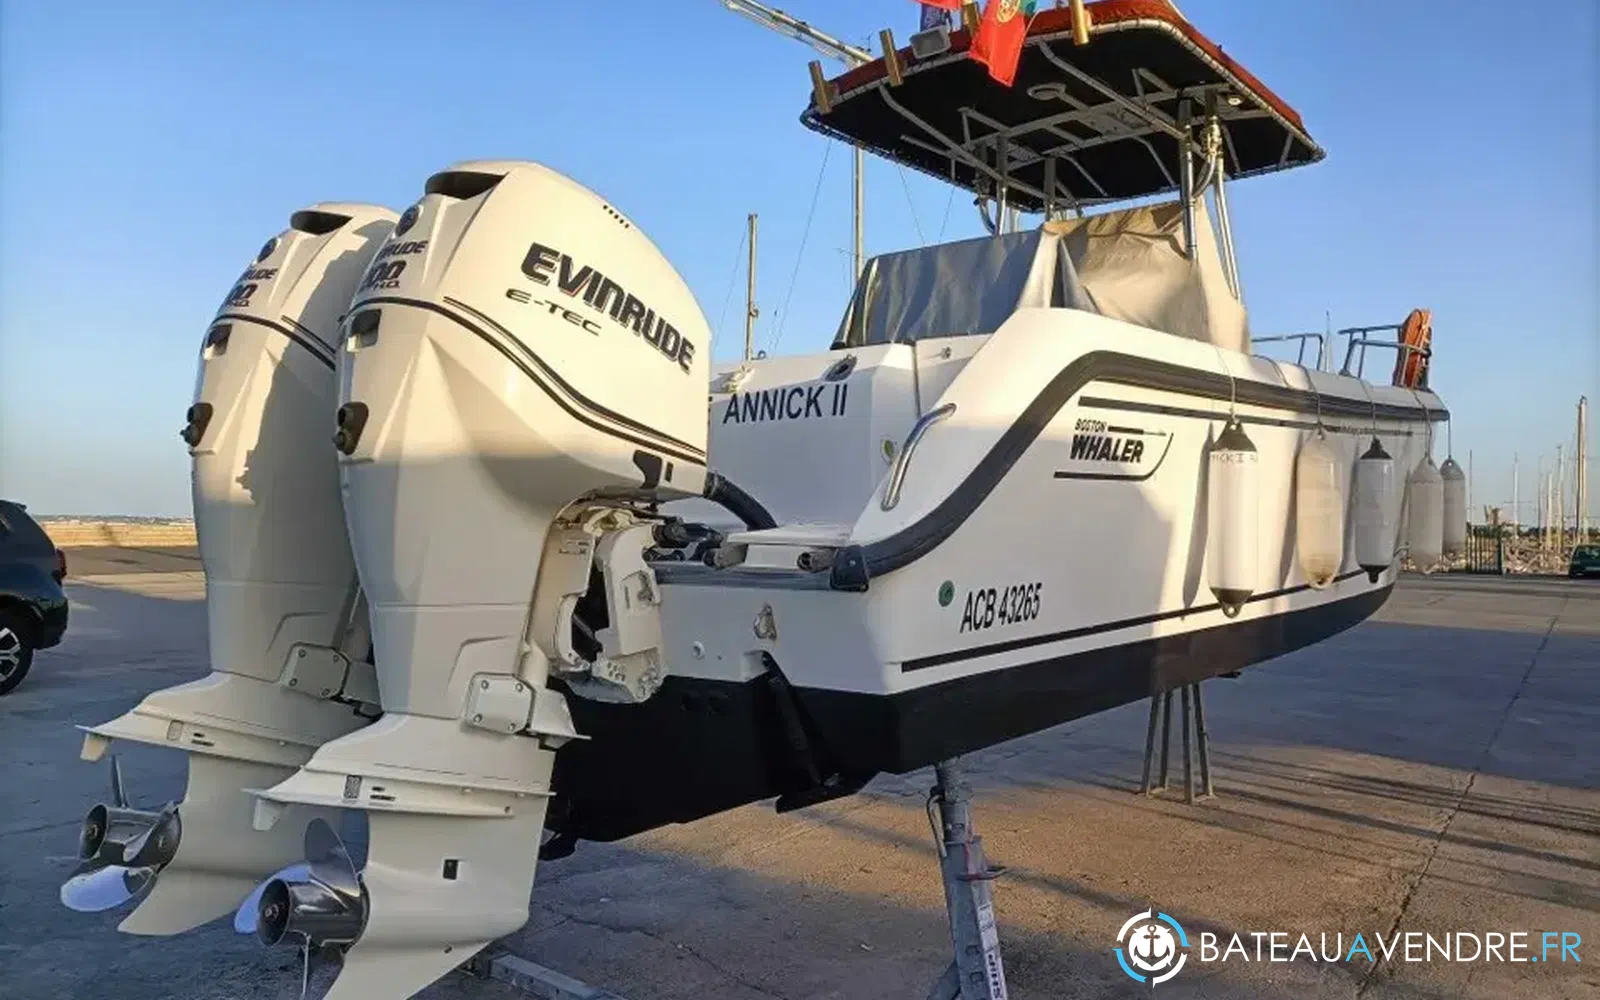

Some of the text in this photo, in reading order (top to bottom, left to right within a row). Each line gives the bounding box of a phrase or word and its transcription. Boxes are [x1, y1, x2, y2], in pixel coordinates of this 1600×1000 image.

[505, 288, 602, 336] E-TEC
[521, 242, 695, 375] EVINRUDE
[722, 383, 848, 424] ANNICK II
[1075, 418, 1107, 432] BOSTON
[1070, 434, 1144, 463] WHALER
[960, 582, 1042, 634] ACB 43265
